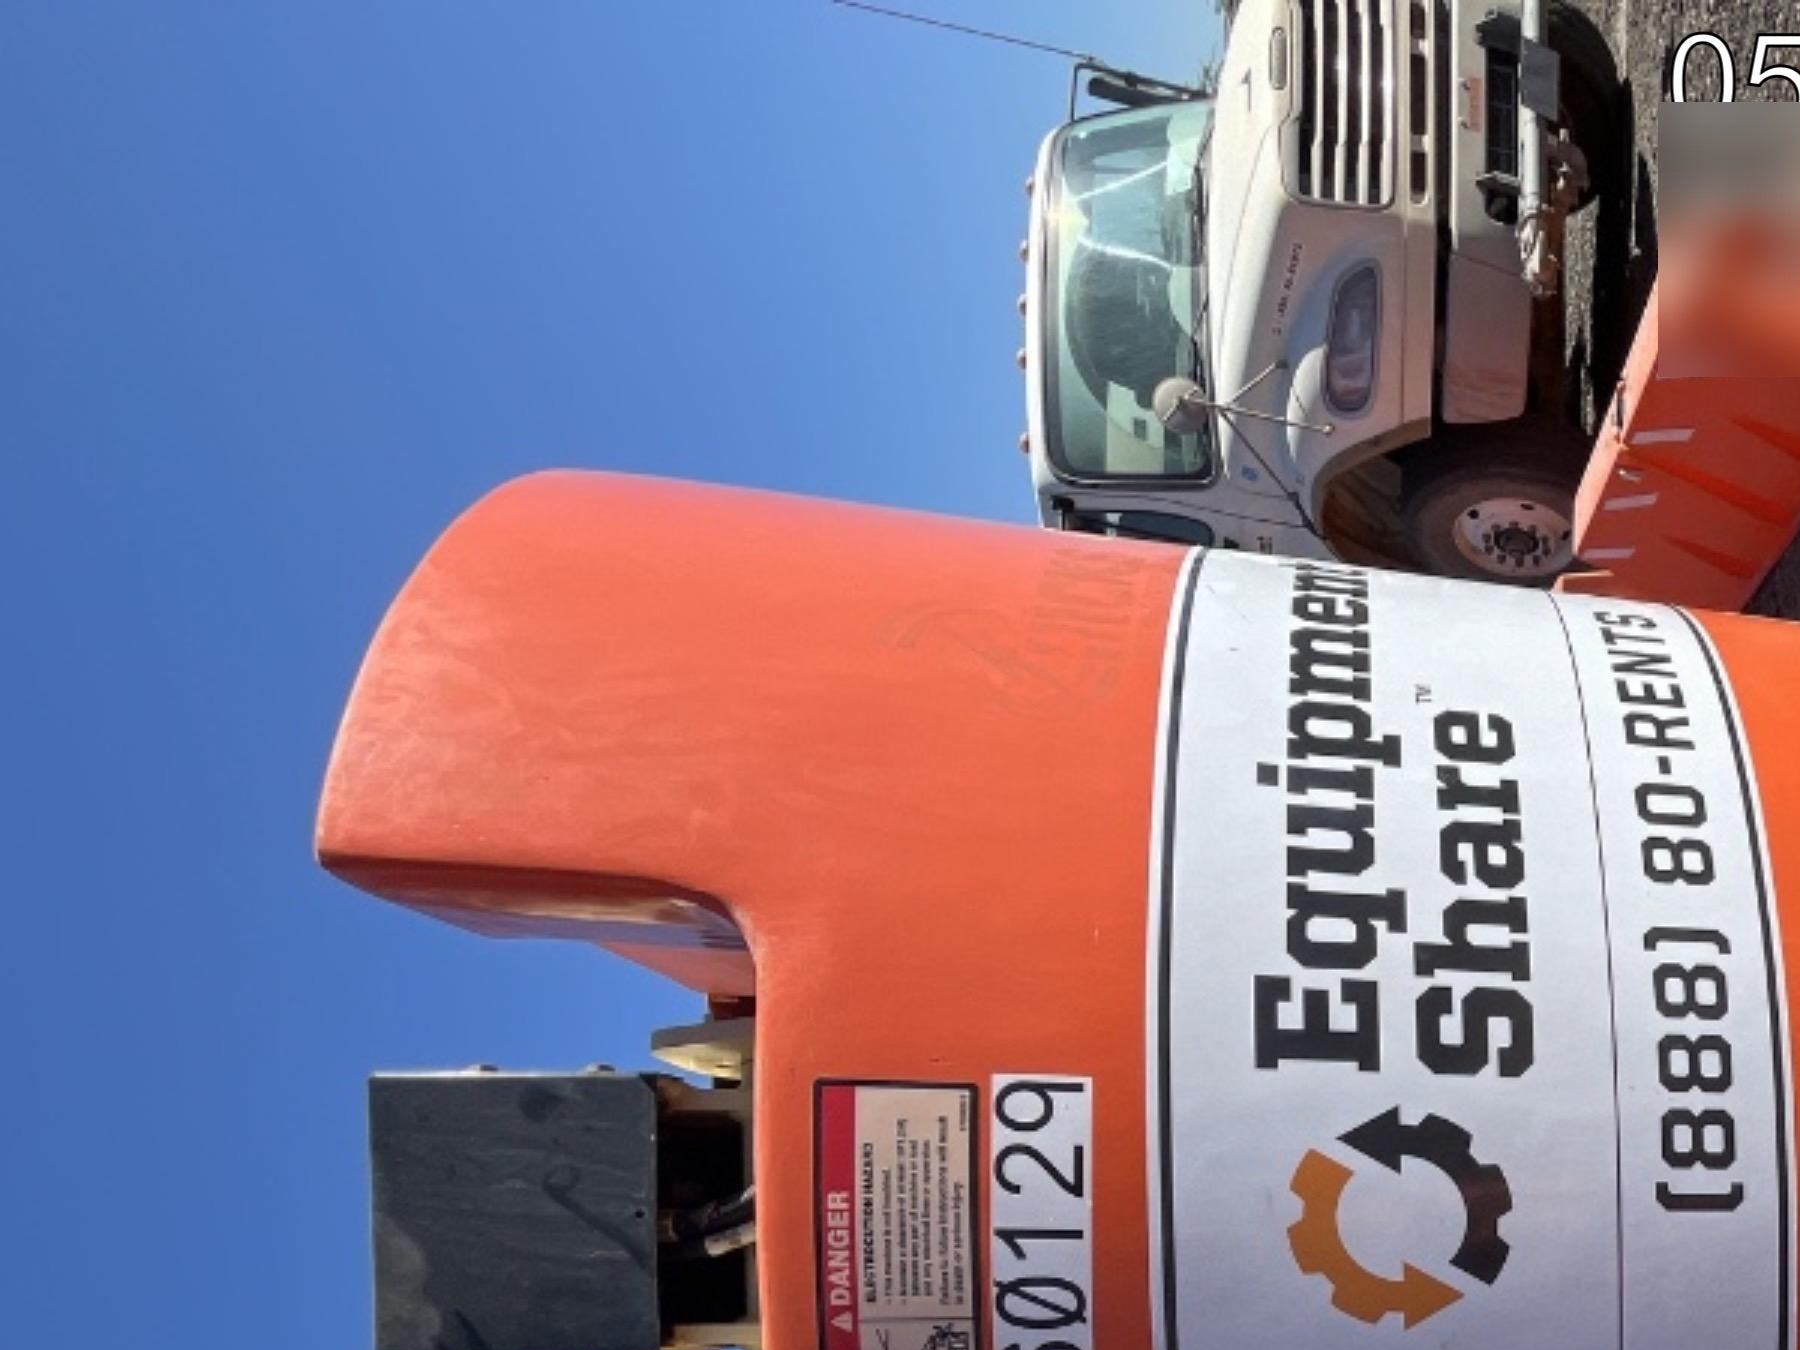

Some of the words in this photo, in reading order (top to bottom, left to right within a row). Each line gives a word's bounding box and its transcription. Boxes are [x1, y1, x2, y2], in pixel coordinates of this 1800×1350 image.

[1594, 611, 1715, 887] 80-RENTS
[1414, 710, 1533, 1078] Share
[1643, 927, 1744, 1213] (888)
[827, 1190, 851, 1306] DANGER
